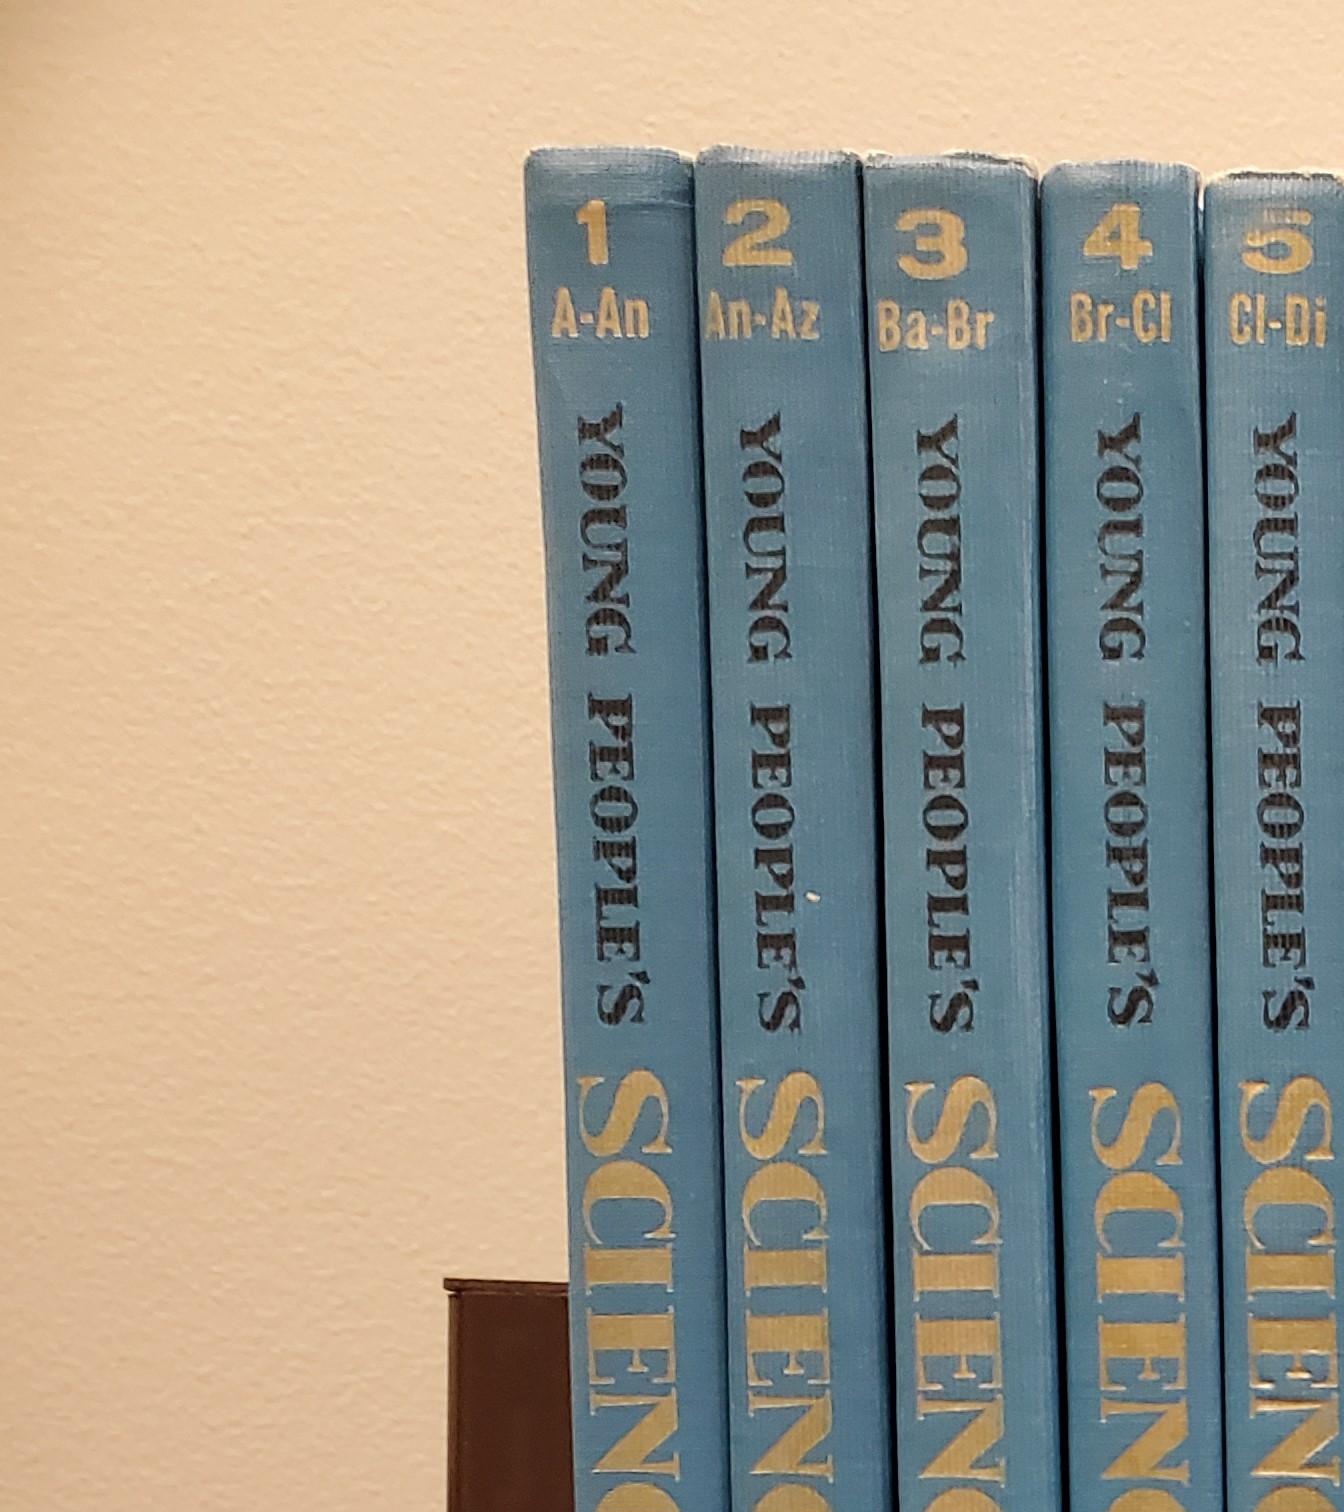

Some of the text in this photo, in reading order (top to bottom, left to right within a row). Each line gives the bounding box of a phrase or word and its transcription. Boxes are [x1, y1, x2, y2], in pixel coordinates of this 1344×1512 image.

[576, 199, 609, 264] 1
[723, 198, 793, 266] 2
[896, 208, 968, 279] 3
[1083, 203, 1153, 269] 4
[1242, 210, 1313, 274] 5
[551, 286, 650, 338] A-An
[706, 287, 819, 339] An-Az
[877, 299, 995, 352] Ba-Br
[1071, 289, 1172, 343] Br-Cl
[1230, 292, 1327, 347] Cl-Di
[577, 402, 636, 656] YOUNG
[916, 413, 966, 667] YOUNG
[1252, 411, 1306, 666] YOUNG
[587, 691, 651, 1025] PEOPLE'S
[921, 702, 980, 1034] PEOPLE'S
[1257, 700, 1315, 1030] PEOPLE'S
